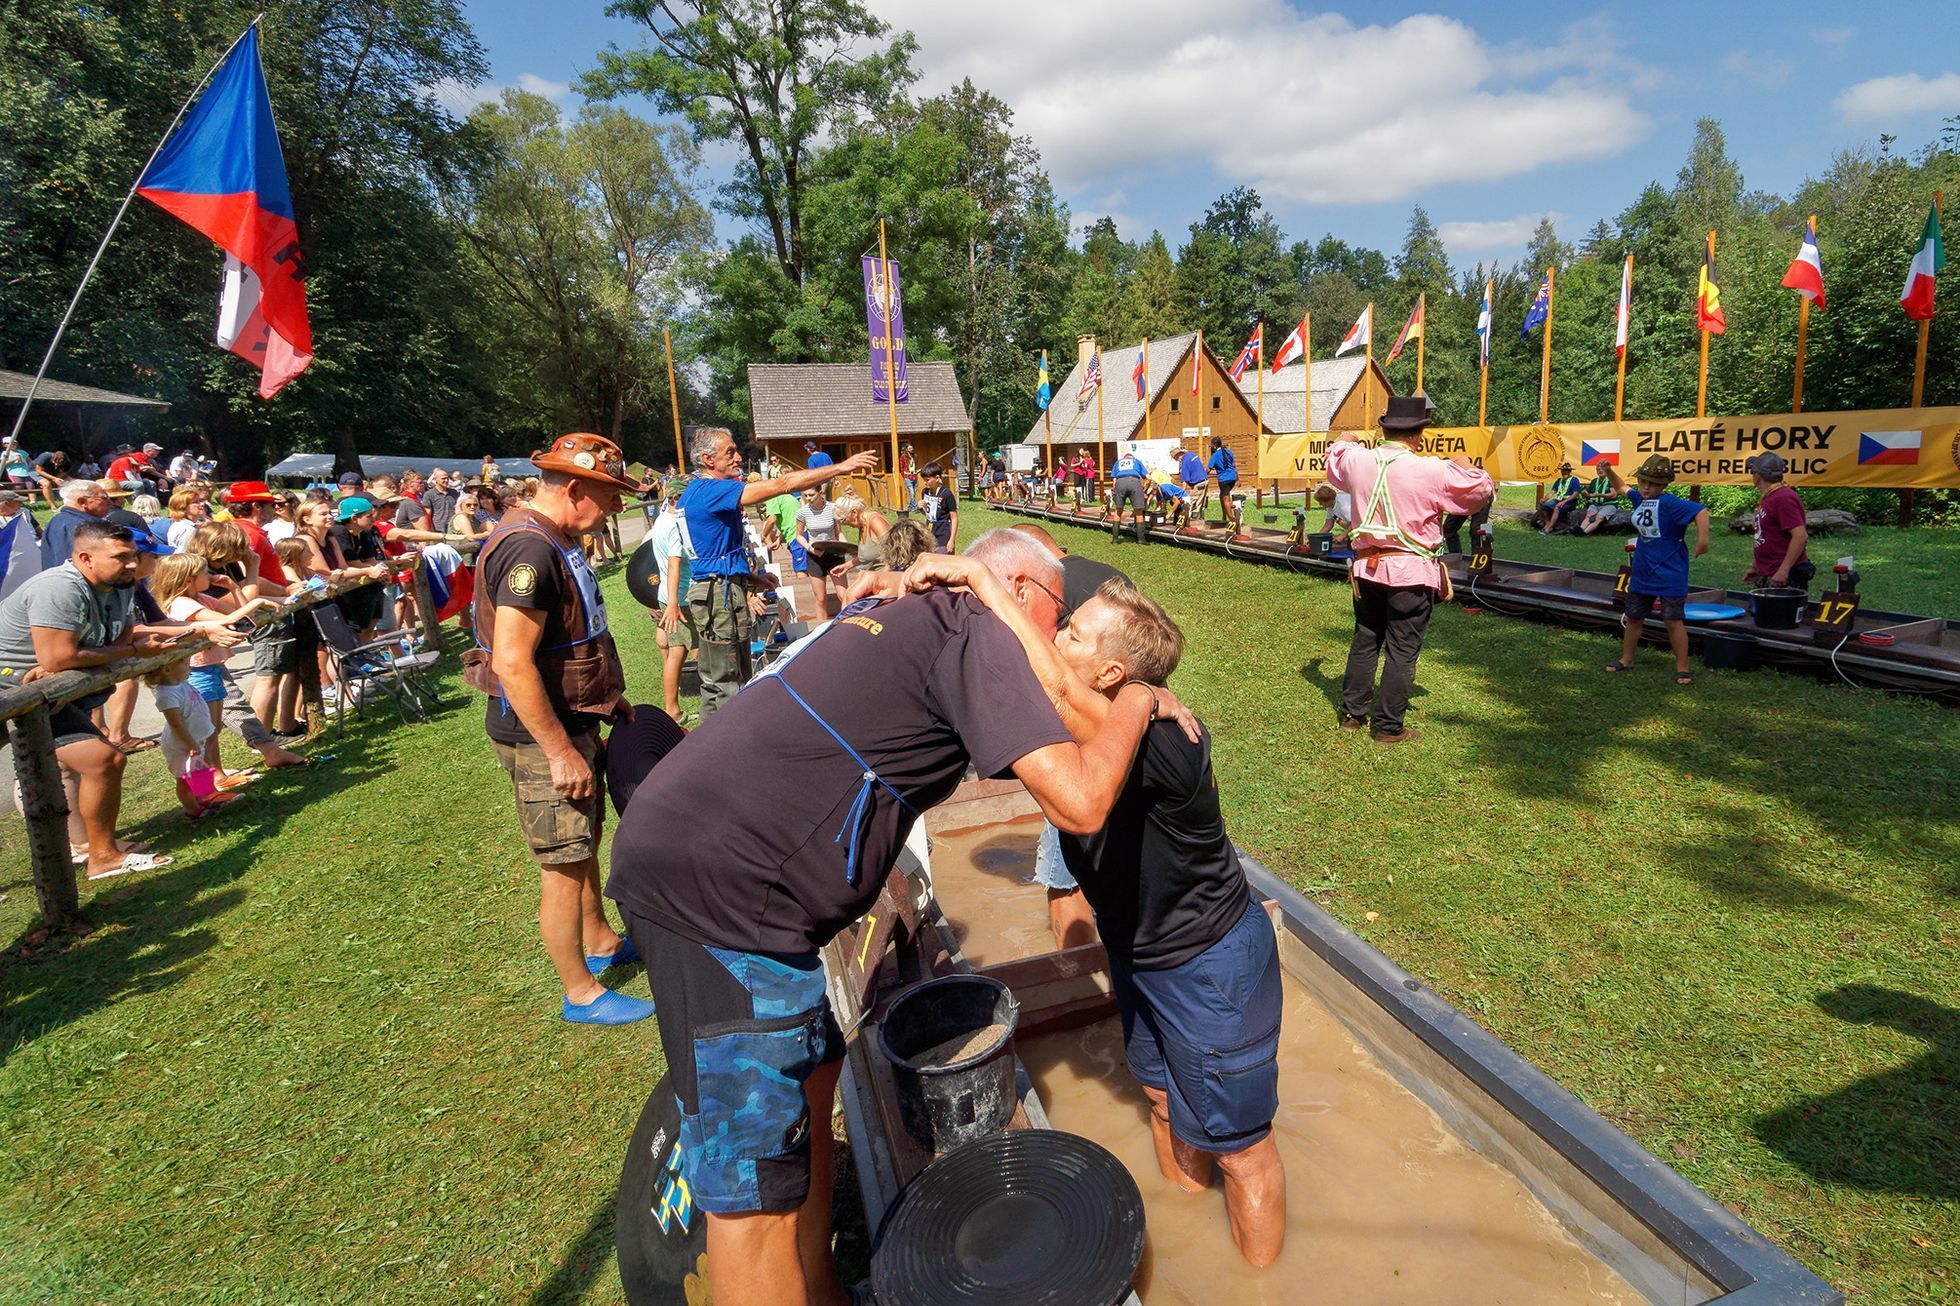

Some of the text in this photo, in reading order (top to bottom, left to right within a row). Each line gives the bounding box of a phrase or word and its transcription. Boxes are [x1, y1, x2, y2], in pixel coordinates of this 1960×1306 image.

[872, 336, 904, 350] GOD
[1416, 434, 1466, 453] SVĚTA
[1636, 423, 1837, 452] ZLATÉ HORY
[1670, 458, 1828, 474] ECH RELIC
[1226, 521, 1236, 532] 22
[1287, 530, 1298, 541] 21
[1469, 553, 1488, 570] 19
[1814, 601, 1855, 625] 17
